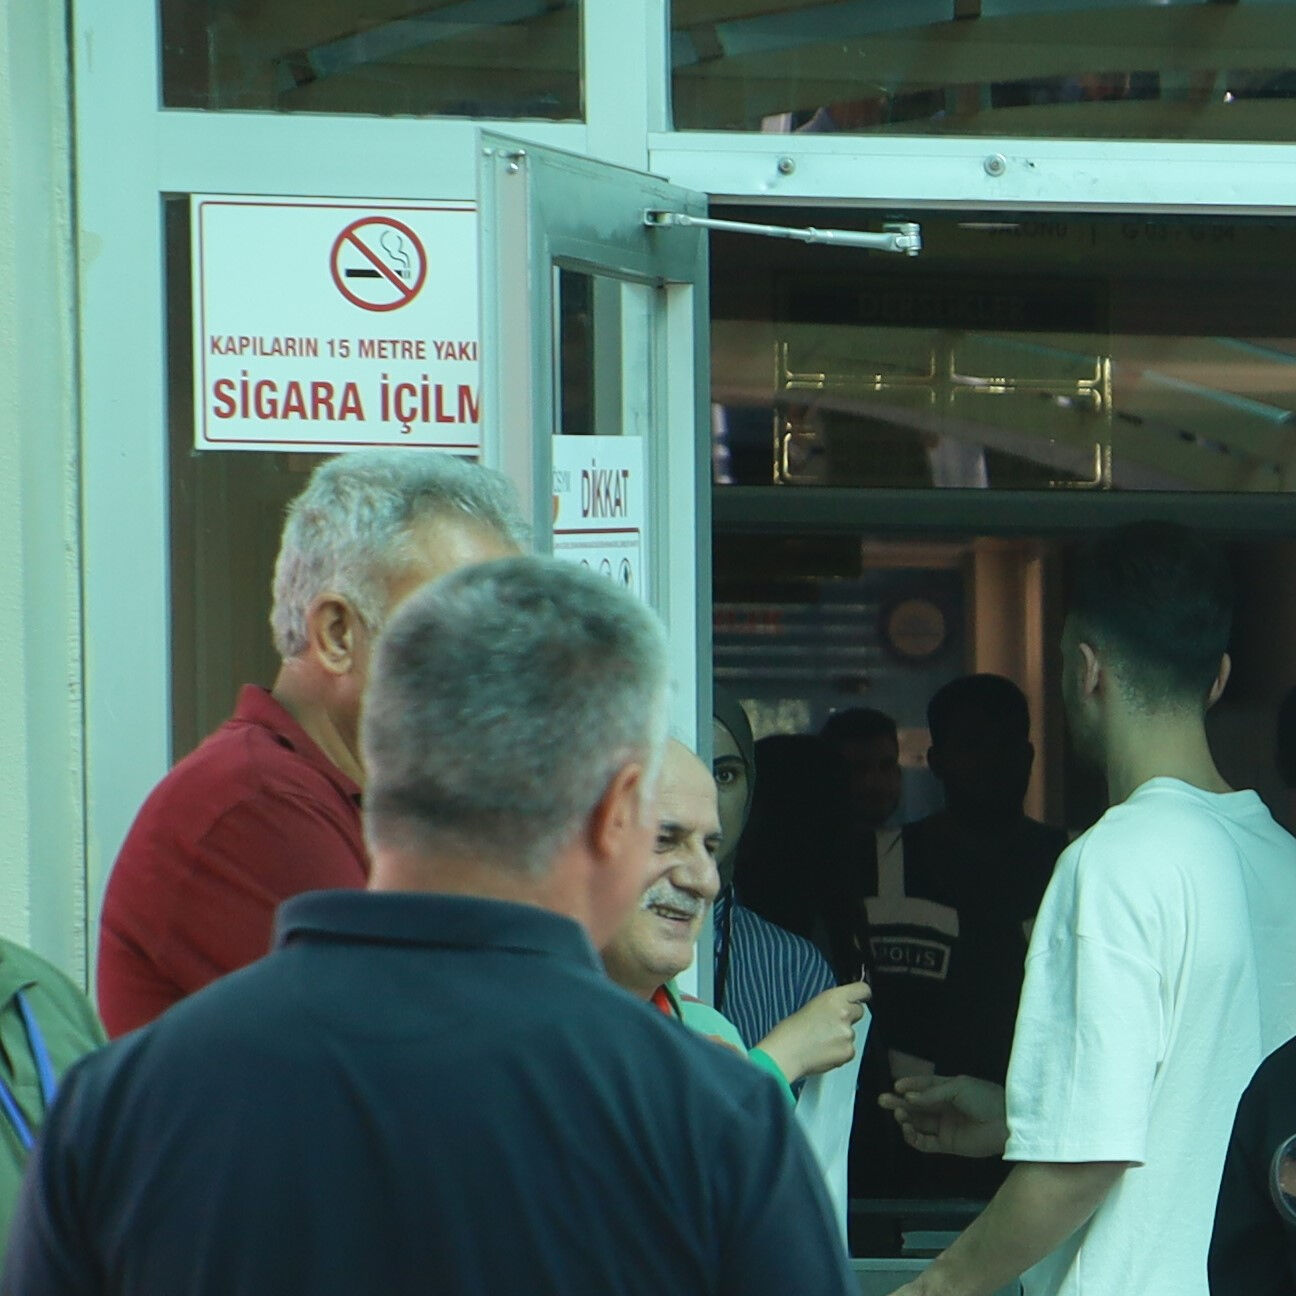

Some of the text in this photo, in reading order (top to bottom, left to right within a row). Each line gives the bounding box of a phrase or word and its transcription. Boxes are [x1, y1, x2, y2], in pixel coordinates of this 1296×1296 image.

[210, 335, 318, 358] KAPILARIN
[327, 338, 351, 358] 15
[358, 339, 426, 361] METRE
[212, 369, 366, 422] SİGARA
[581, 458, 630, 518] DİKKAT
